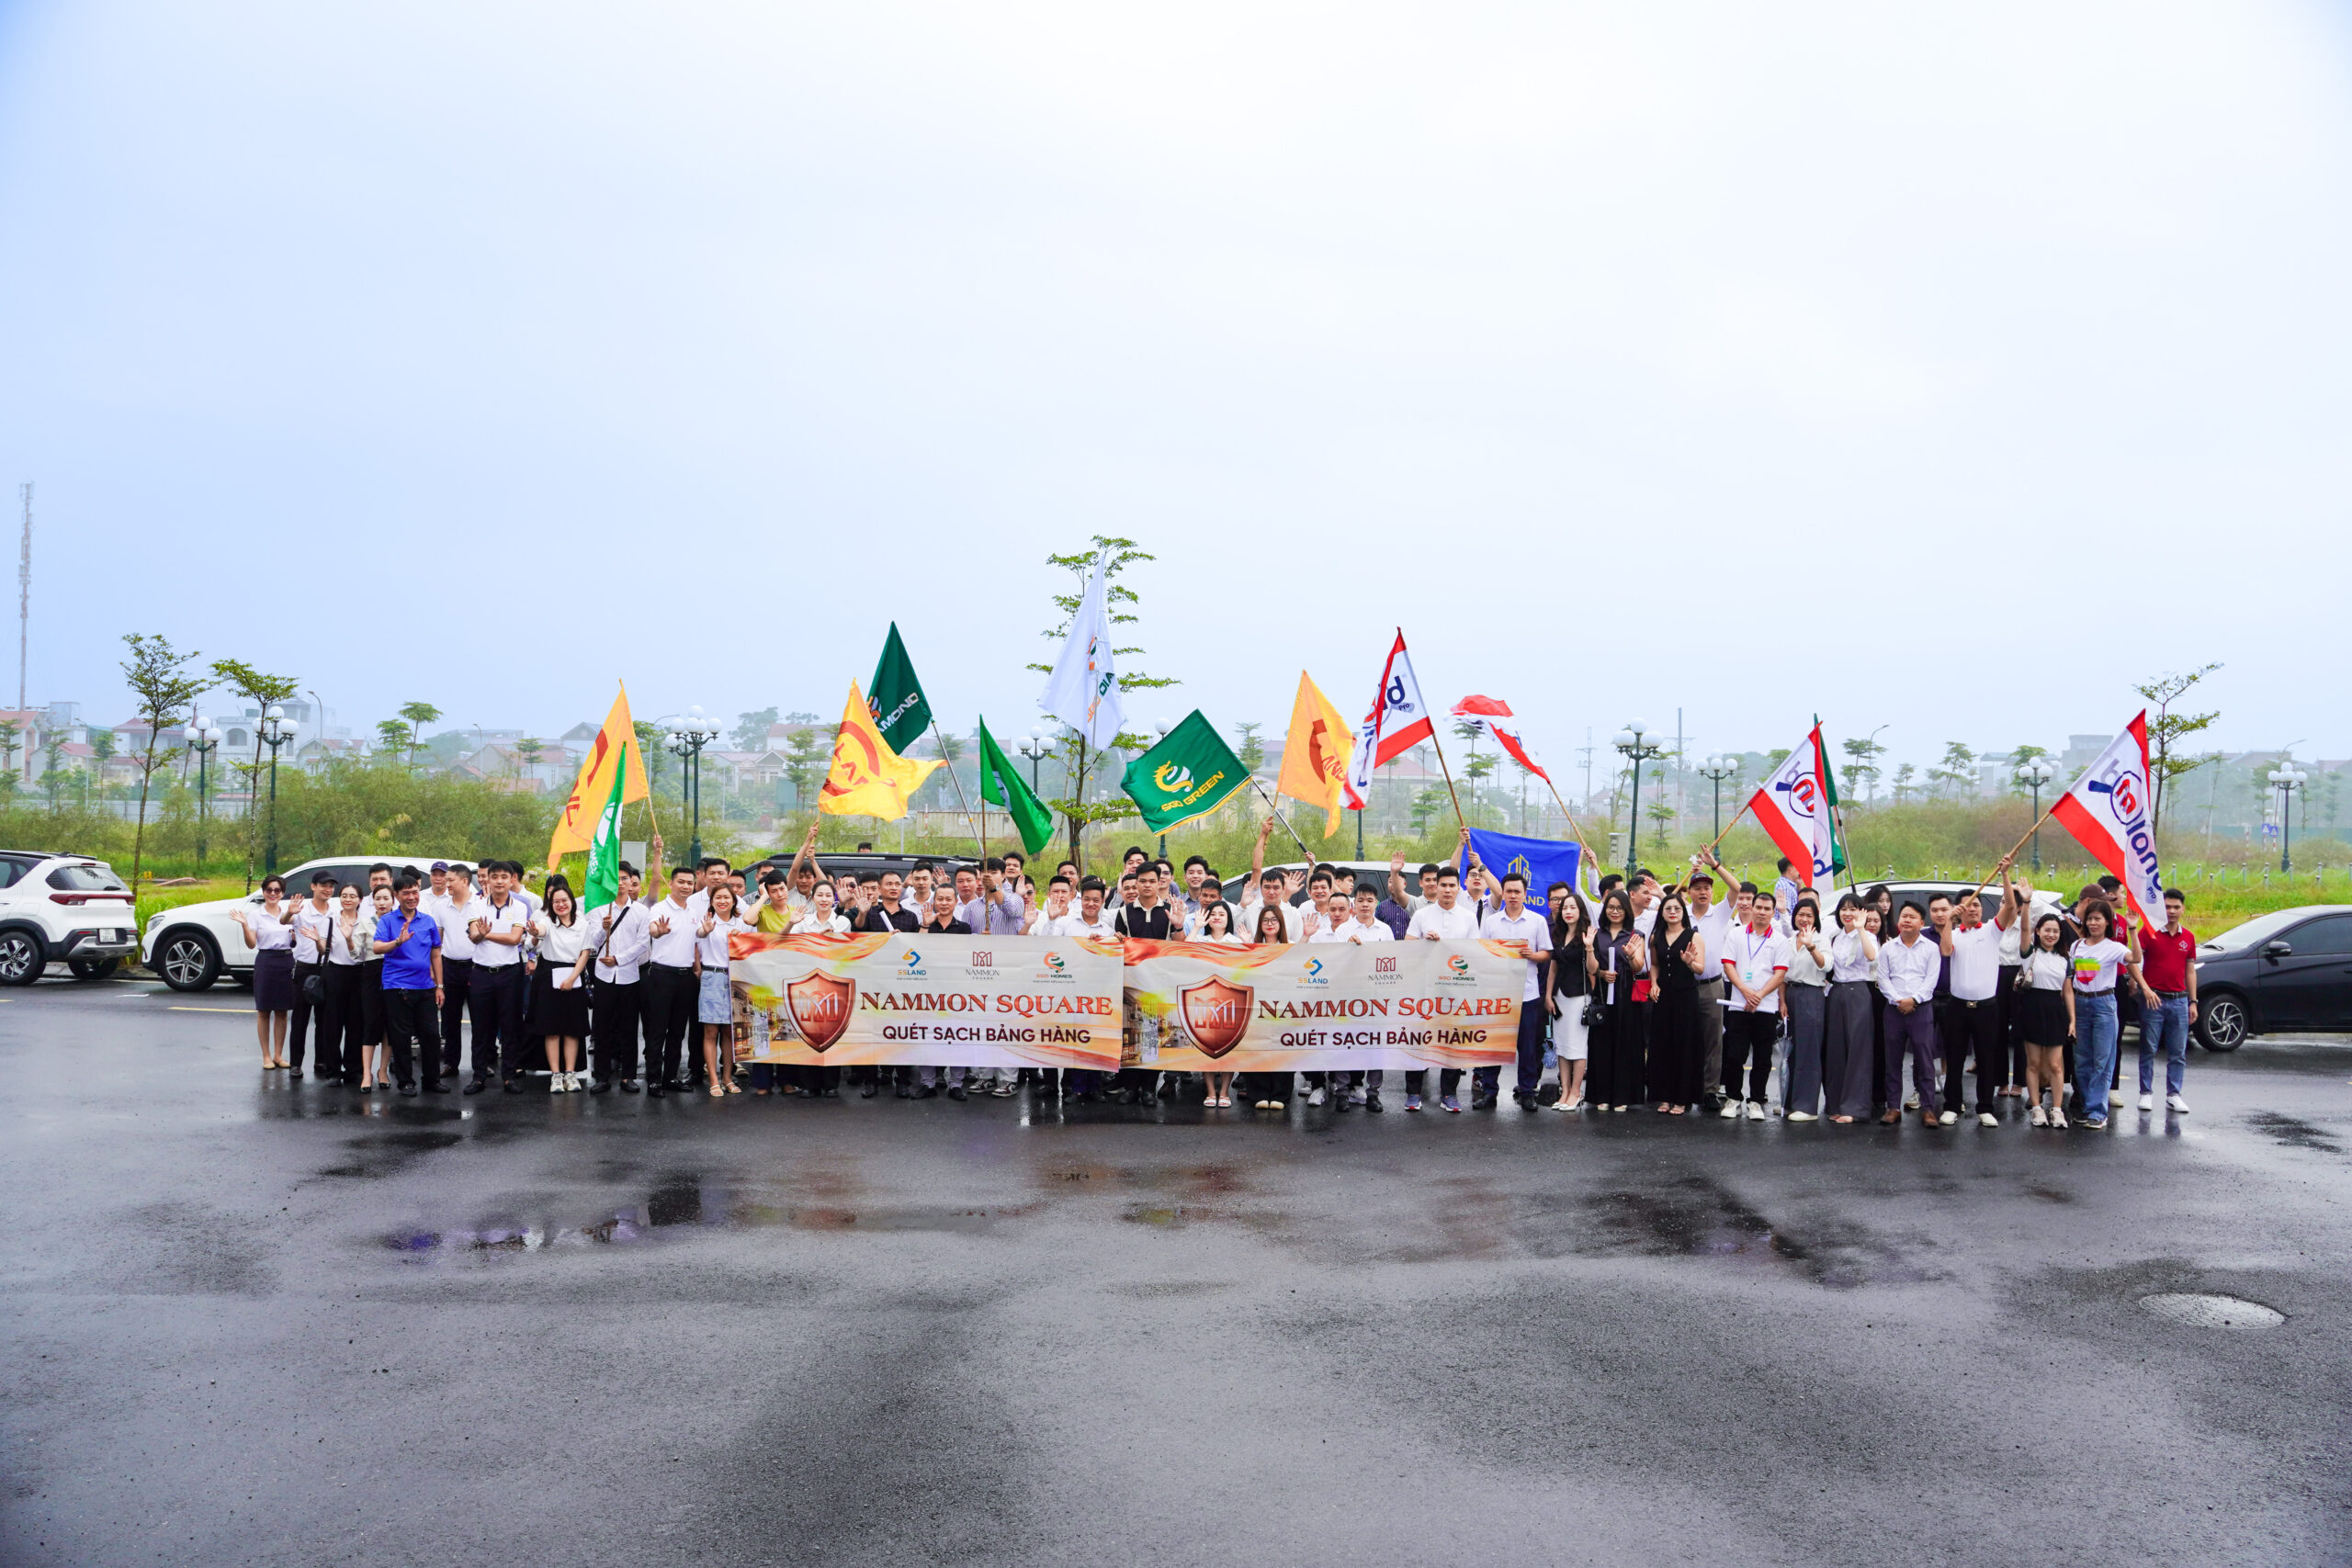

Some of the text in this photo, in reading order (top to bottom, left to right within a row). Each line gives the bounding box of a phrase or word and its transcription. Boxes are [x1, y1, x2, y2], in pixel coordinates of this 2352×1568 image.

[1398, 703, 1410, 711] Pro
[1182, 770, 1226, 806] GREEN
[2146, 886, 2157, 900] Pro
[860, 992, 1114, 1019] NAMMON SQUARE
[1258, 997, 1512, 1020] NAMMON SQUARE
[883, 1022, 1091, 1044] QUÉT SẠCH BẢNG HÀNG
[1280, 1026, 1487, 1049] QUÉT SẠCH BẢNG HÀNG
